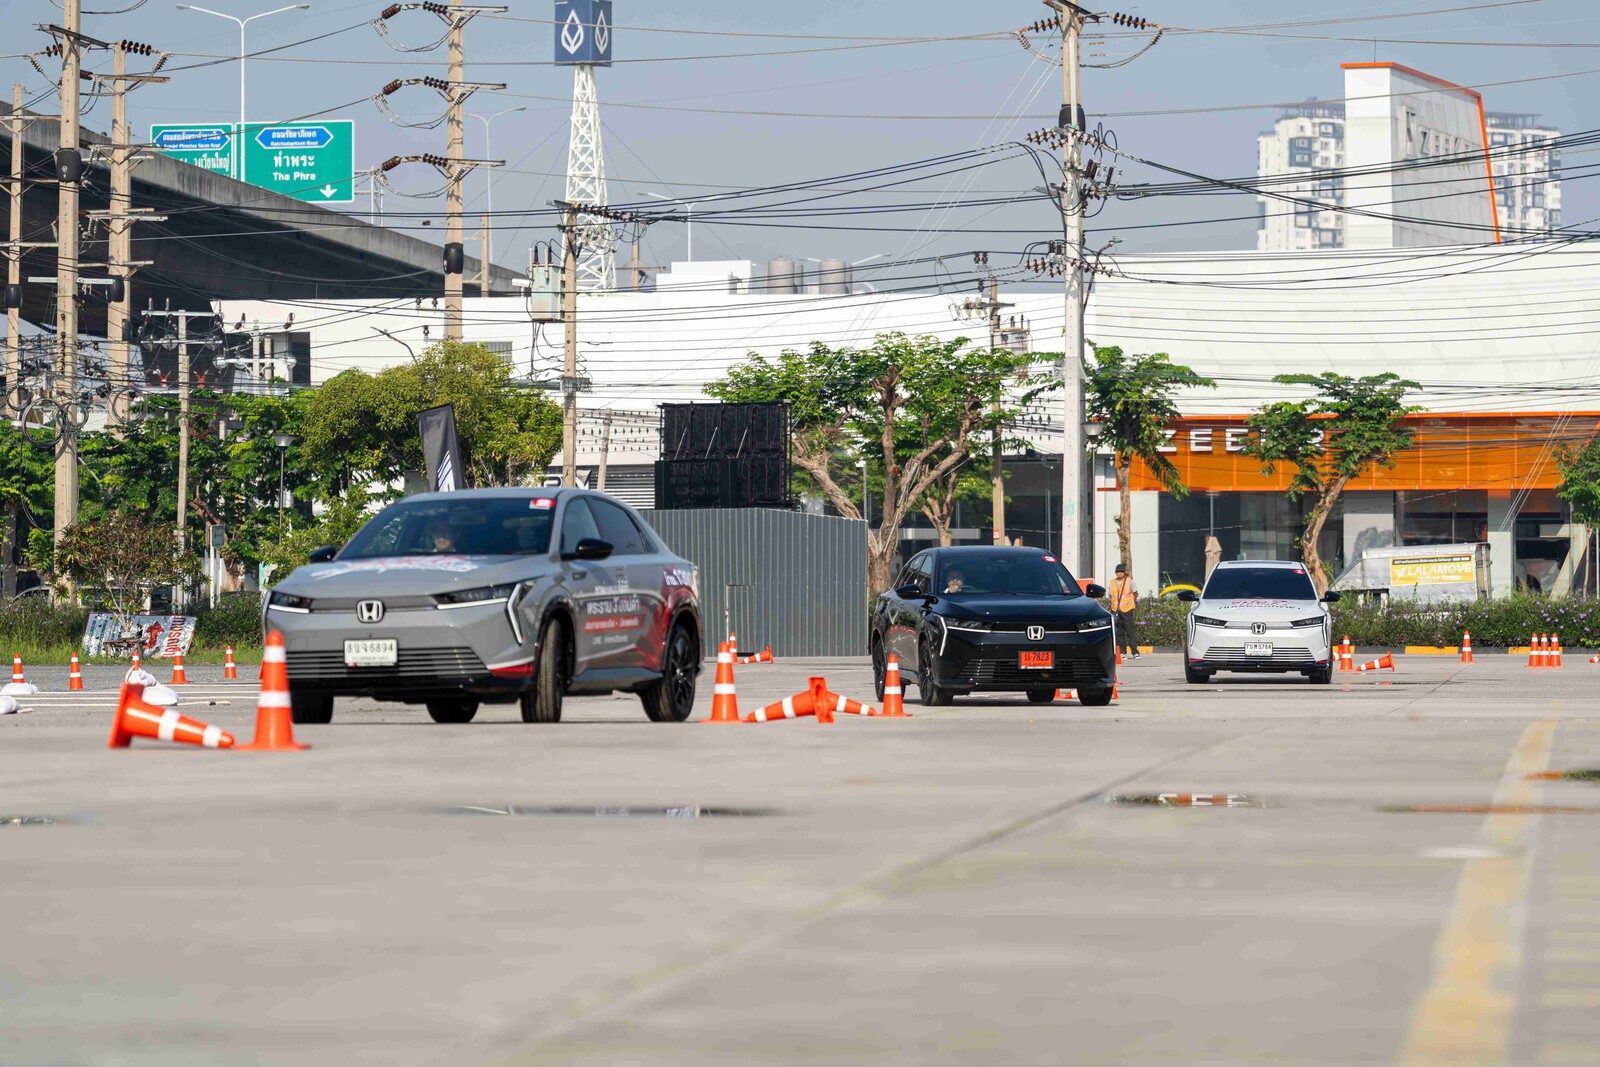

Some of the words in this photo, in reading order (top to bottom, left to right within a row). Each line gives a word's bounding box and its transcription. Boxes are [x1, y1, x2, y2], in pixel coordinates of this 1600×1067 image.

[273, 150, 315, 168] ท่าพระ
[272, 171, 290, 181] Tha
[293, 171, 316, 181] Phra
[1156, 427, 1325, 452] ZEER
[1408, 563, 1472, 576] LALAMOVE
